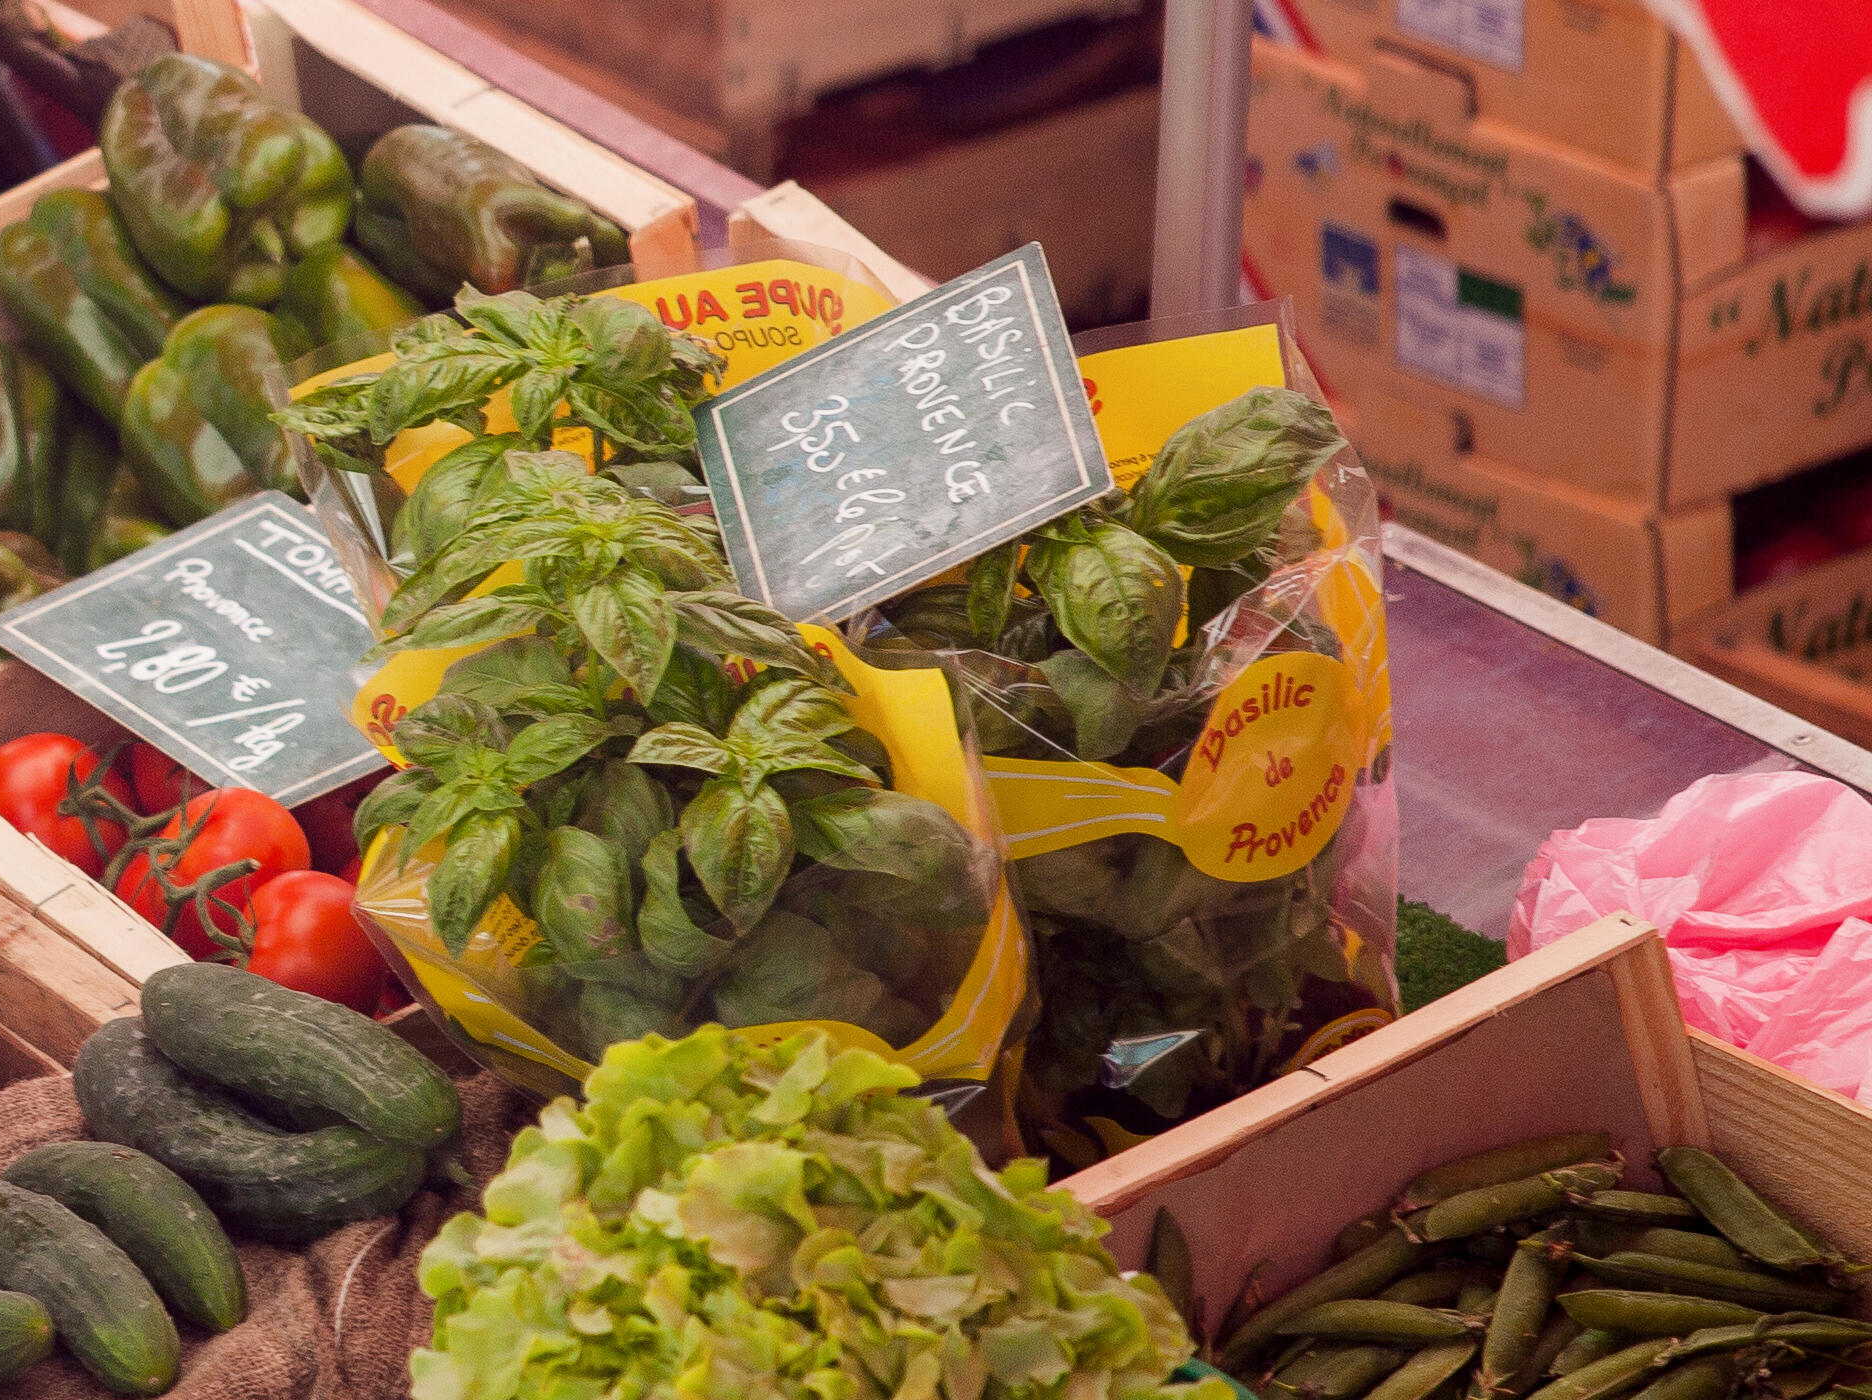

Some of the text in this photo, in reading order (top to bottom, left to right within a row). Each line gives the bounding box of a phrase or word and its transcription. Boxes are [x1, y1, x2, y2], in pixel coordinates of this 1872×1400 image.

[884, 322, 992, 504] PROVENCE
[164, 557, 274, 644] Provence
[96, 620, 229, 694] 2,80
[1200, 672, 1315, 773] Basilic
[1265, 750, 1293, 787] de
[1224, 763, 1345, 864] Provence
